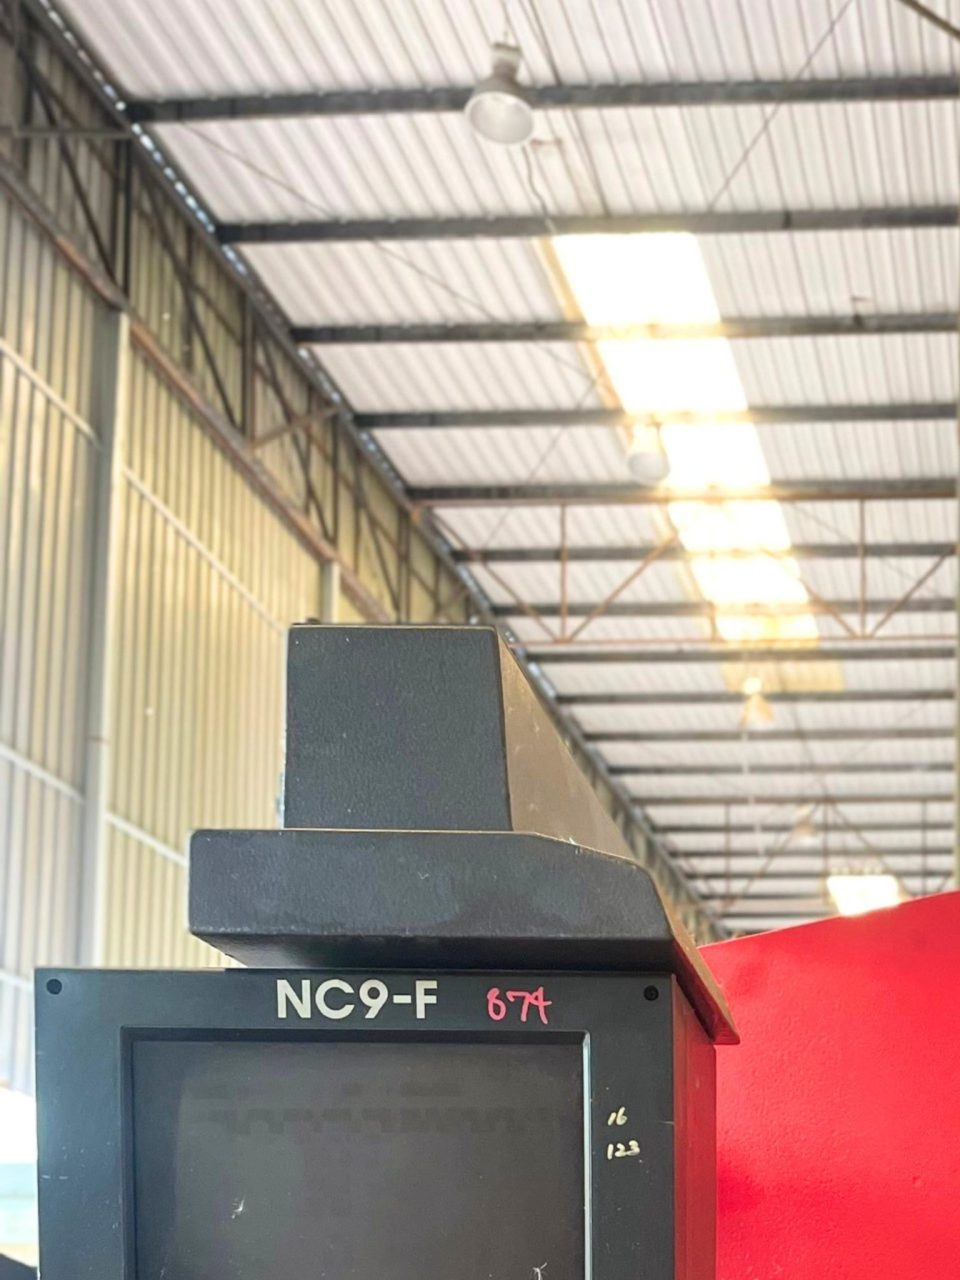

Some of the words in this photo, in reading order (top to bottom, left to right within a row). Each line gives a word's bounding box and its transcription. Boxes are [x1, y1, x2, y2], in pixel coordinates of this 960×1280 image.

[276, 979, 438, 1019] NC9-F
[607, 1106, 628, 1126] 16
[607, 1140, 640, 1160] 123
